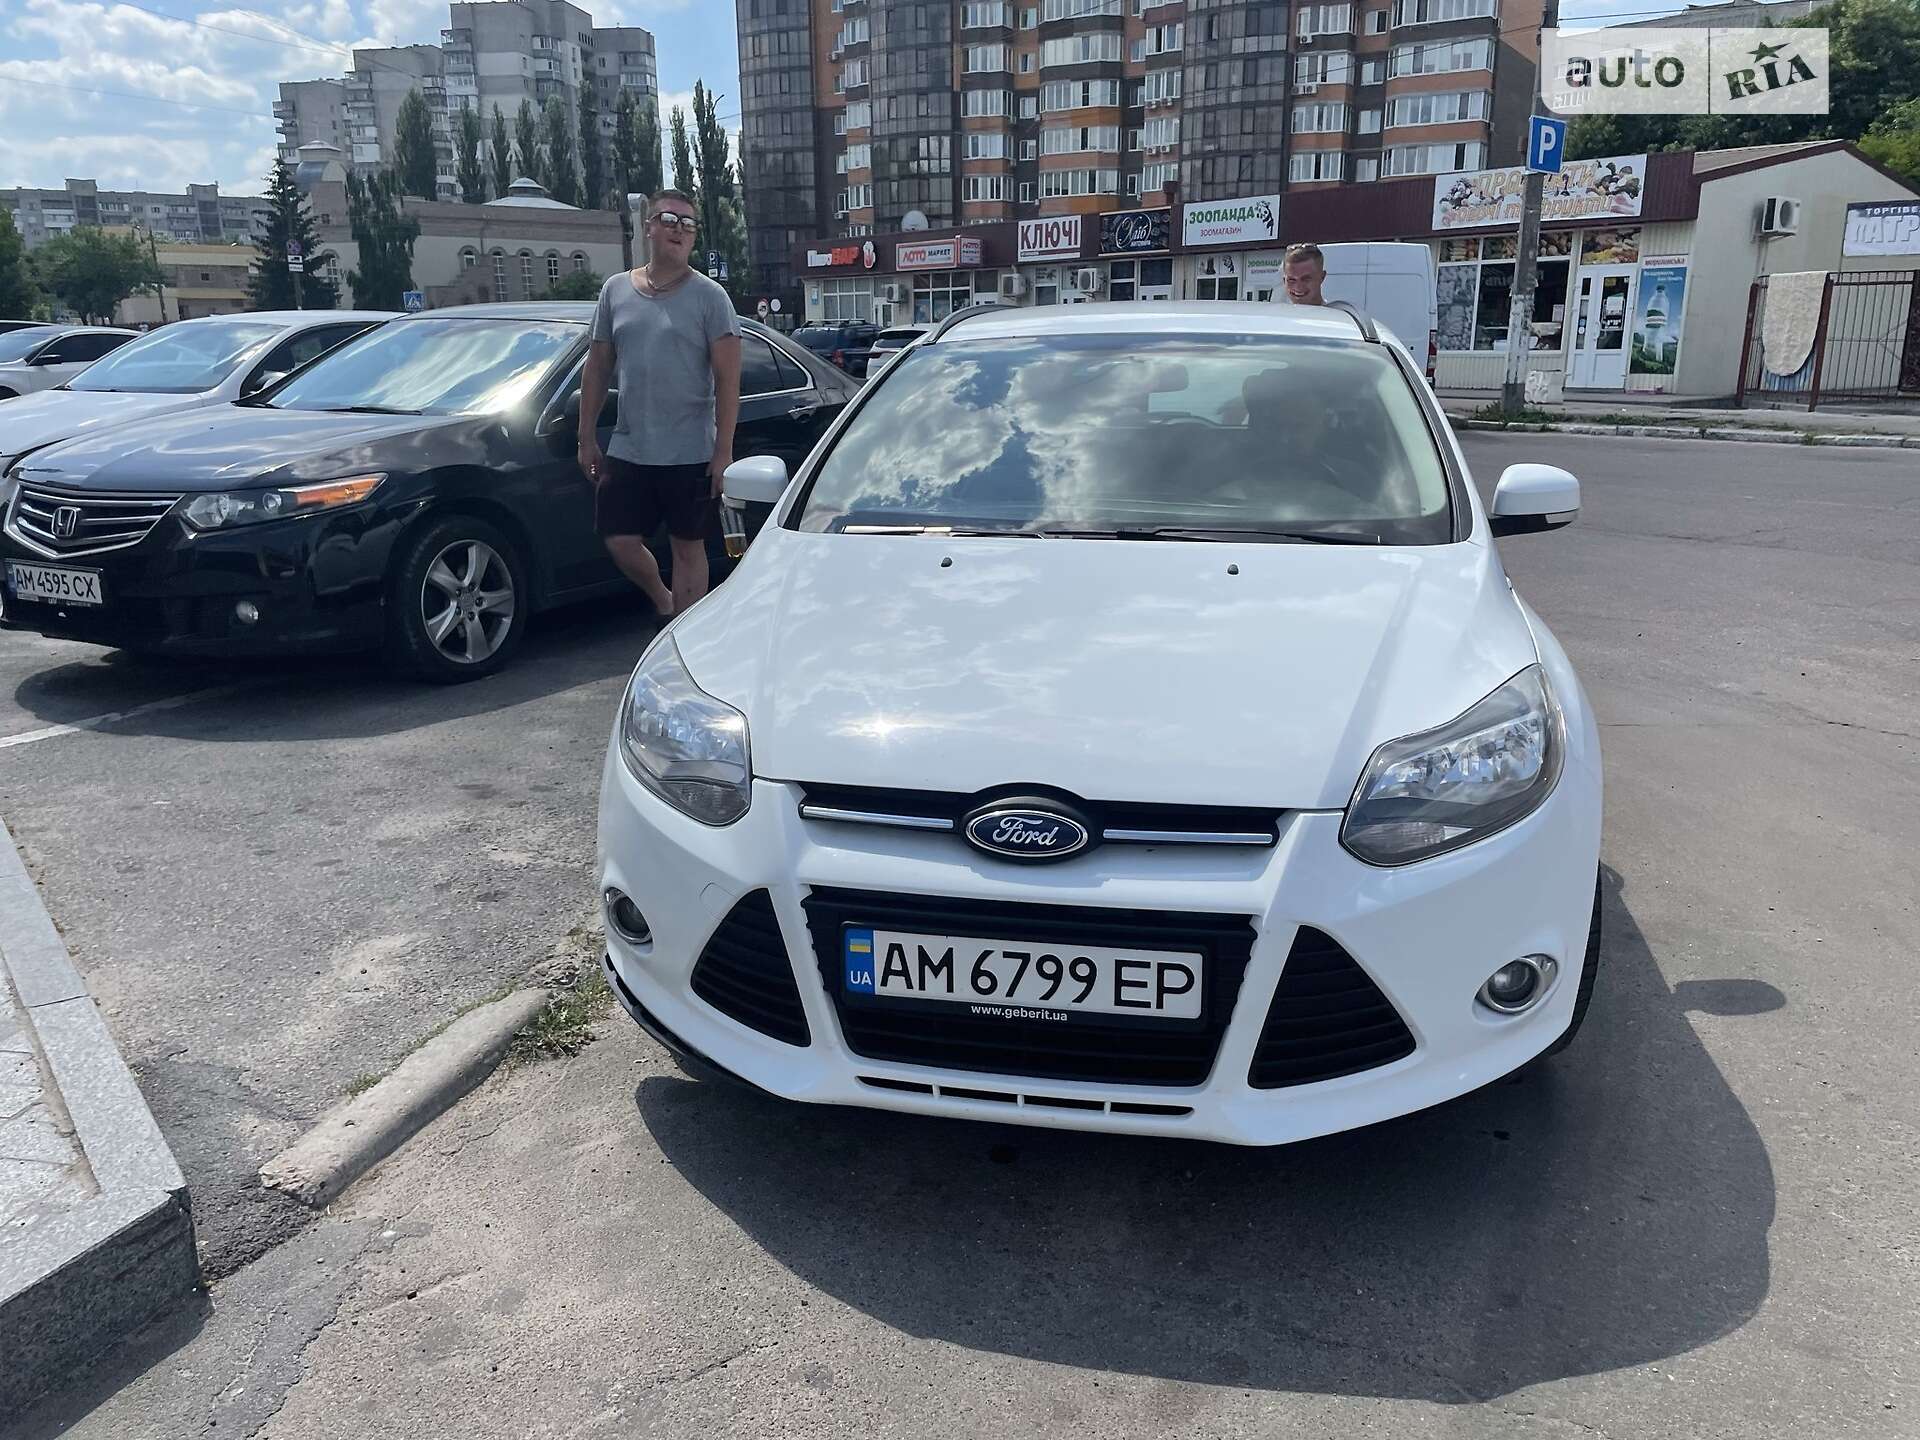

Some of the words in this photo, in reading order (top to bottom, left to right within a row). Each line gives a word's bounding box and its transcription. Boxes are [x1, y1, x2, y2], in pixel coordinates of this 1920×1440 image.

[1538, 125, 1556, 164] P
[1189, 206, 1255, 224] ЗООПАНДА
[1020, 219, 1078, 249] КЛЮЧІ
[1200, 227, 1242, 237] ЗООМАГАЗИН
[903, 250, 926, 262] ЛОТО
[928, 248, 951, 256] МАРКЕТ
[16, 568, 35, 591] AM
[38, 571, 70, 595] 4595
[73, 575, 96, 599] CX
[992, 816, 1059, 846] Ford
[850, 969, 872, 985] UA
[880, 942, 954, 993] AM
[970, 950, 1098, 1004] 6799
[1114, 958, 1195, 1009] EP
[971, 1004, 1068, 1021] www.geberit.ua
